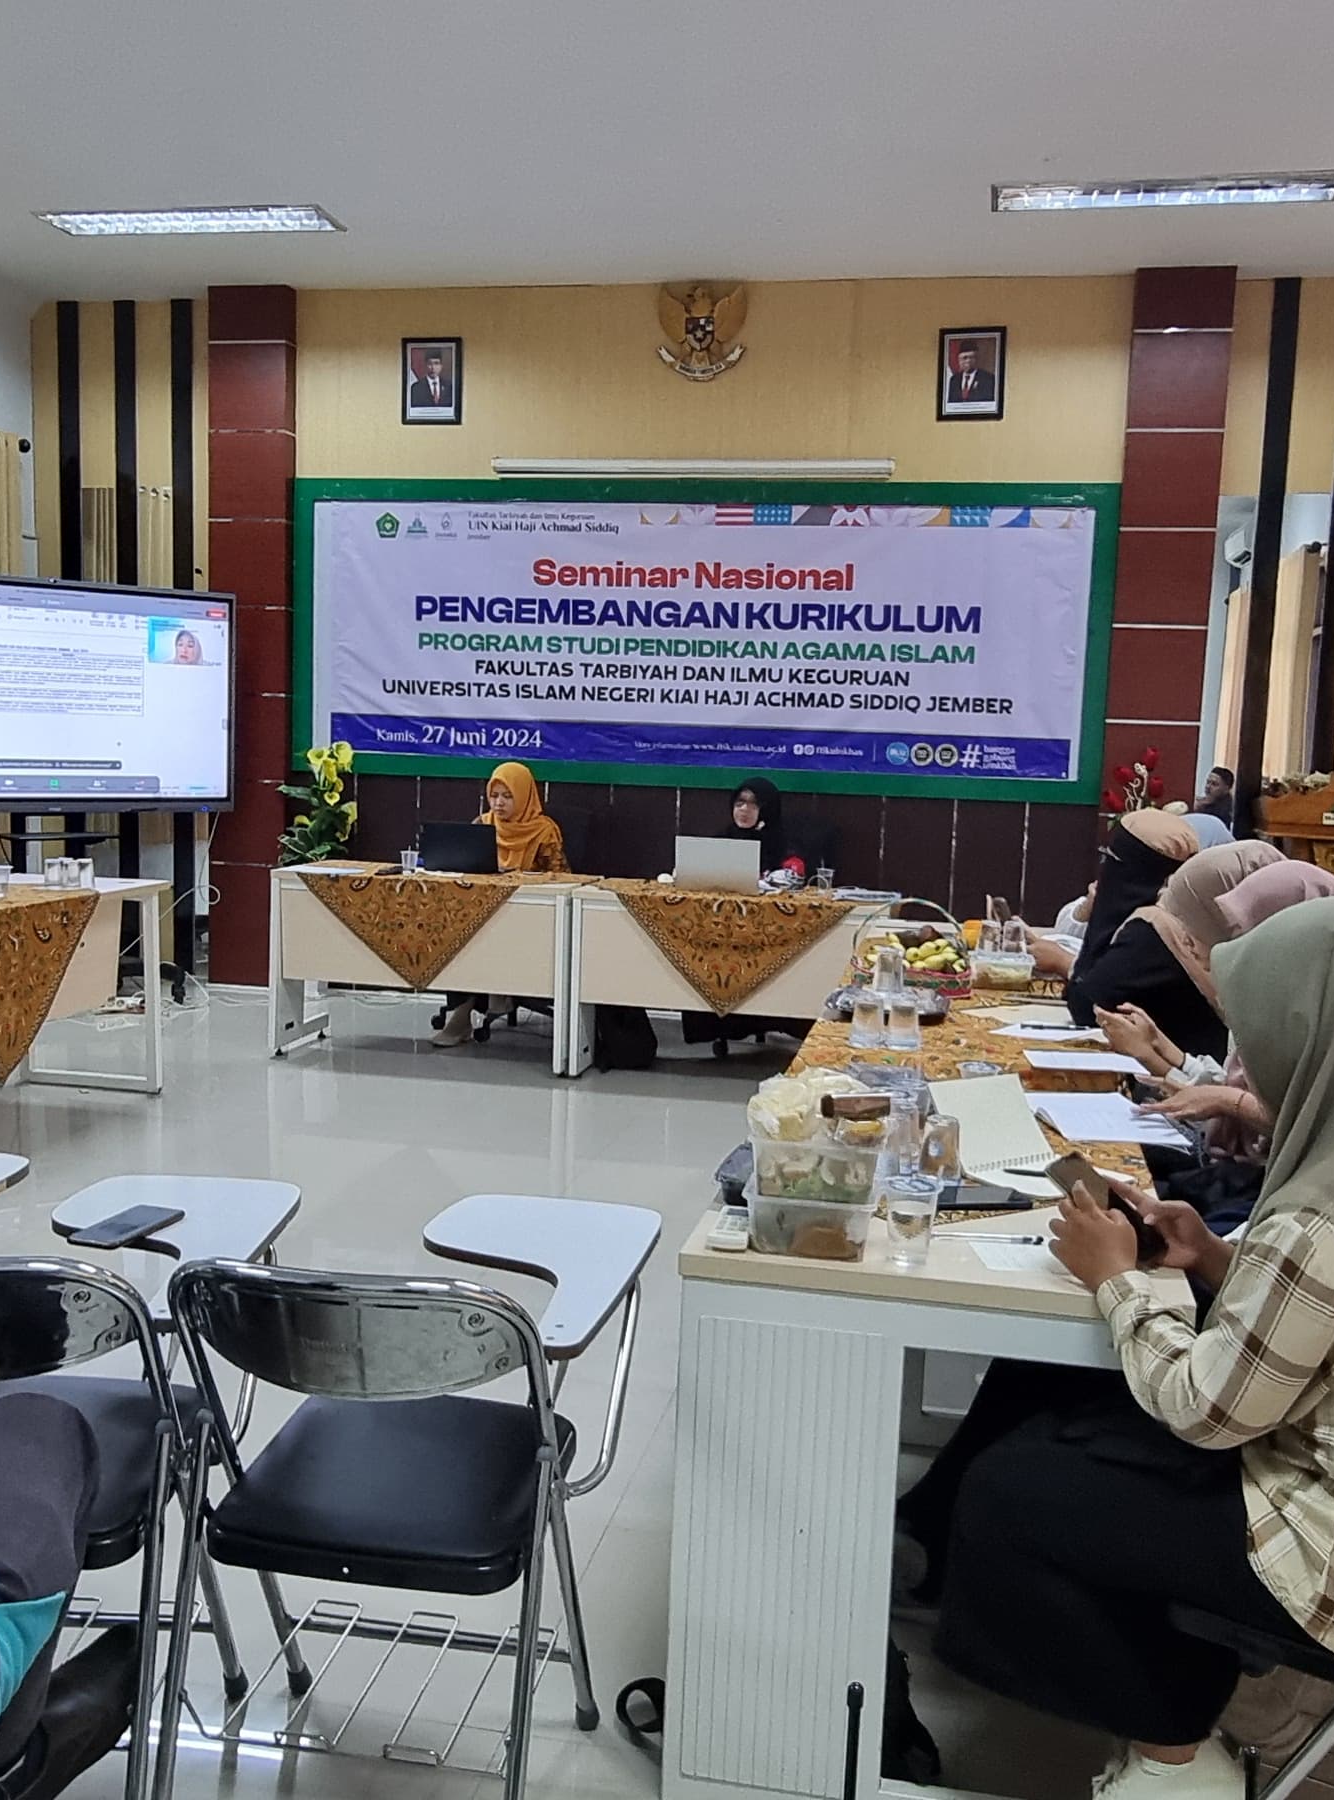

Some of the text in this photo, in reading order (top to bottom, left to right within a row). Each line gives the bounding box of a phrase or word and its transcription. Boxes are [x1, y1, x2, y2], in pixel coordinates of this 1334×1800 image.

[468, 520, 619, 535] UIN Kiai Haji Achmad Siddiq
[533, 558, 854, 591] Seminar Nasional
[415, 595, 982, 634] PENGEMBANGAN KURIKULUM
[418, 632, 976, 664] PROGRAM STUDI PENDIDIKAN AGAMA ISLAM
[475, 659, 910, 687] FAKULTAS TARBIYAH DAN ILMU KEGURUAN
[382, 679, 1013, 714] UNIVERSITAS ISLAM NEGERI KIAI HAJI ACHMAD SIDDIQ JEMBER
[376, 725, 543, 747] Kamis, 27 Juni 2024
